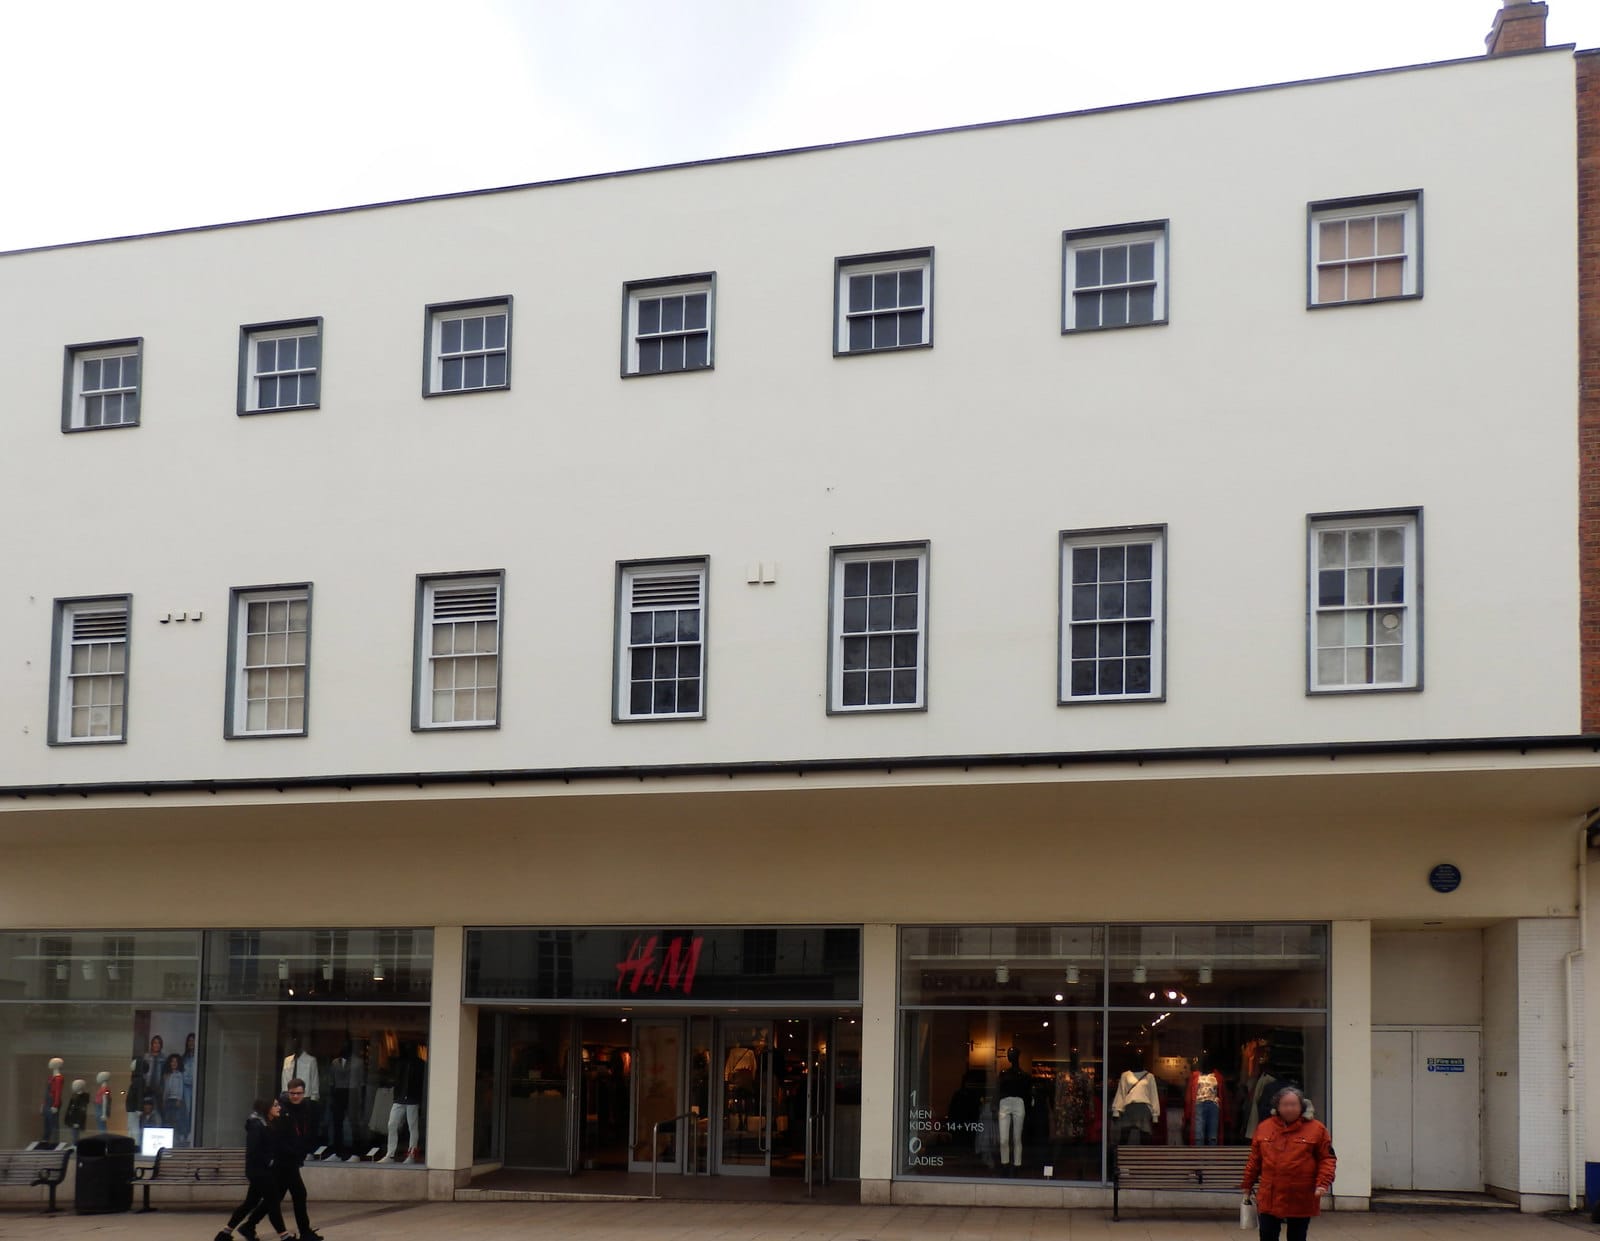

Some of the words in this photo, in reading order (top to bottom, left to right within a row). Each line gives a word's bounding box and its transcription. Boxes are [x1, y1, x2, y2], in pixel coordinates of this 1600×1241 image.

[615, 934, 704, 994] H&M
[910, 1090, 917, 1107] 1
[909, 1109, 932, 1120] MEN
[909, 1121, 932, 1131] KIDS
[909, 1136, 922, 1154] 0
[908, 1156, 944, 1167] LADIES
